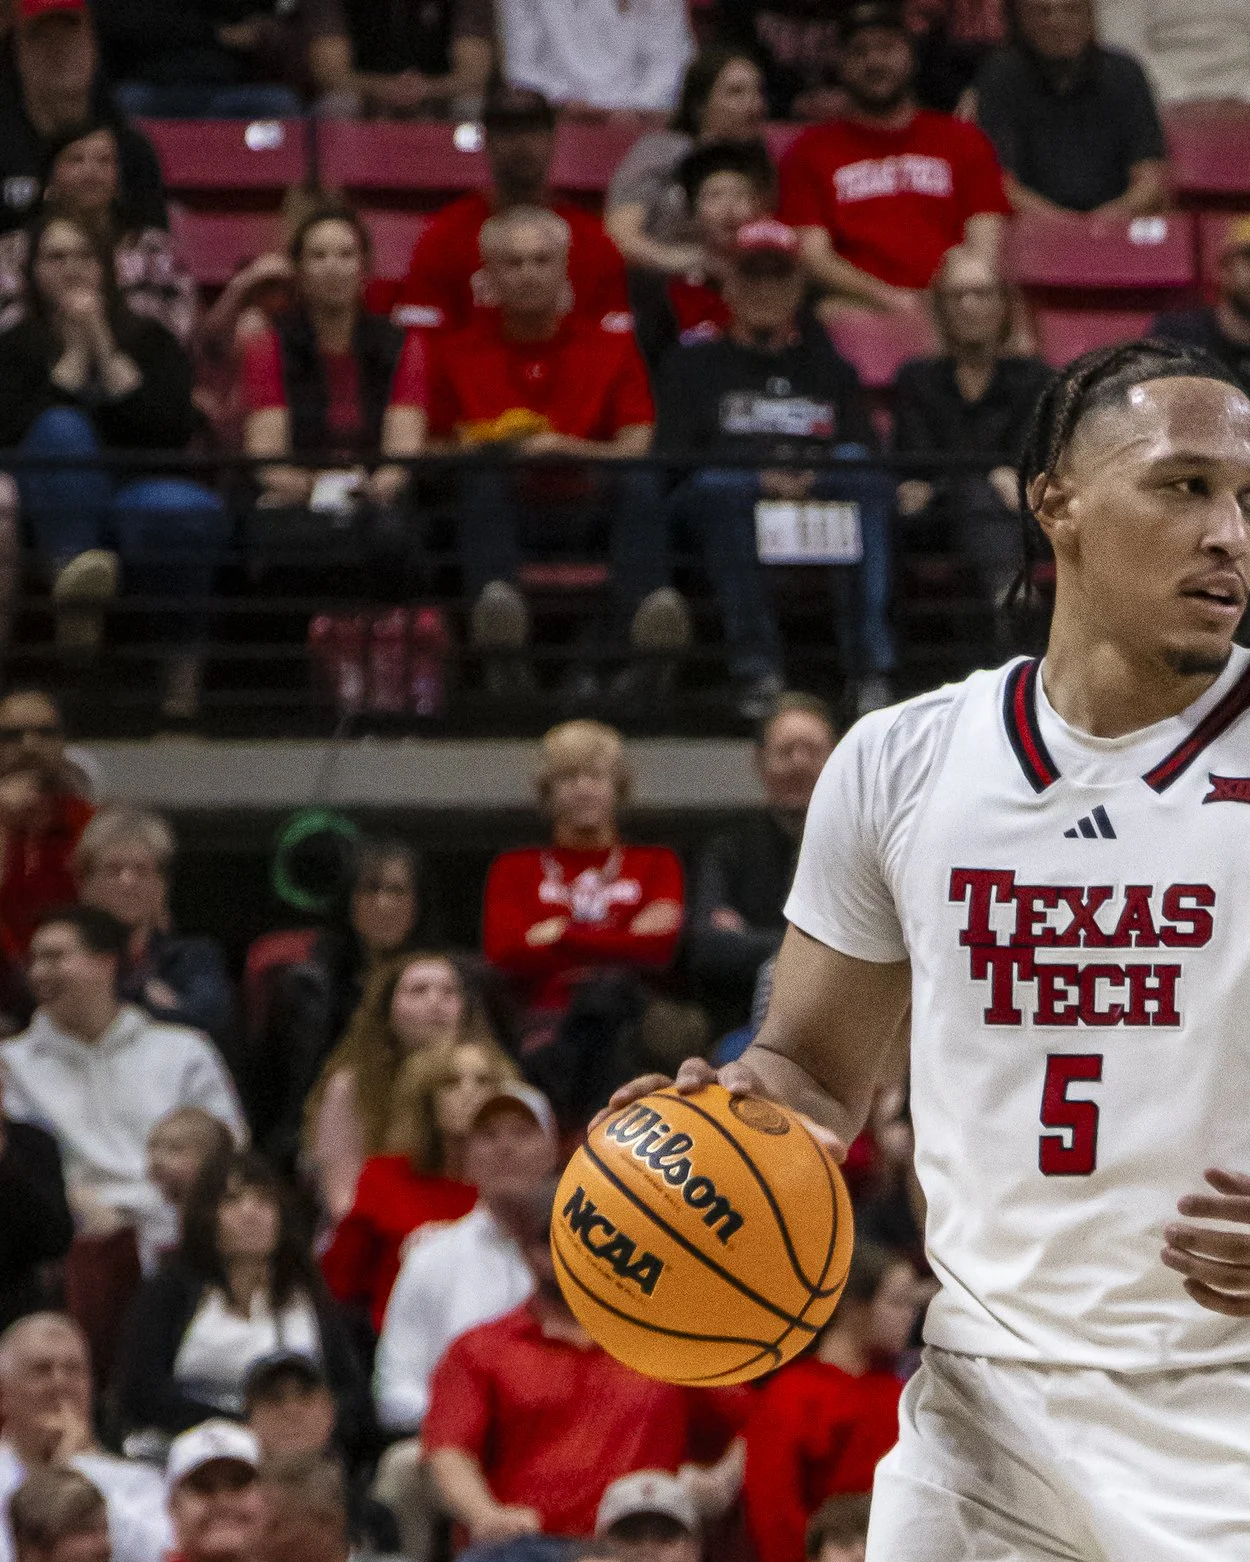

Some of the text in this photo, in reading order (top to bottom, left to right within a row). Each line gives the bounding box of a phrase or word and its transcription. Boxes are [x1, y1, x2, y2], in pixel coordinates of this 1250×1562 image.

[948, 867, 1217, 949] TEXAS
[969, 945, 1182, 1027] TECH
[1038, 1053, 1103, 1177] 5
[605, 1103, 745, 1246] Wilson
[562, 1186, 665, 1298] NCAA
